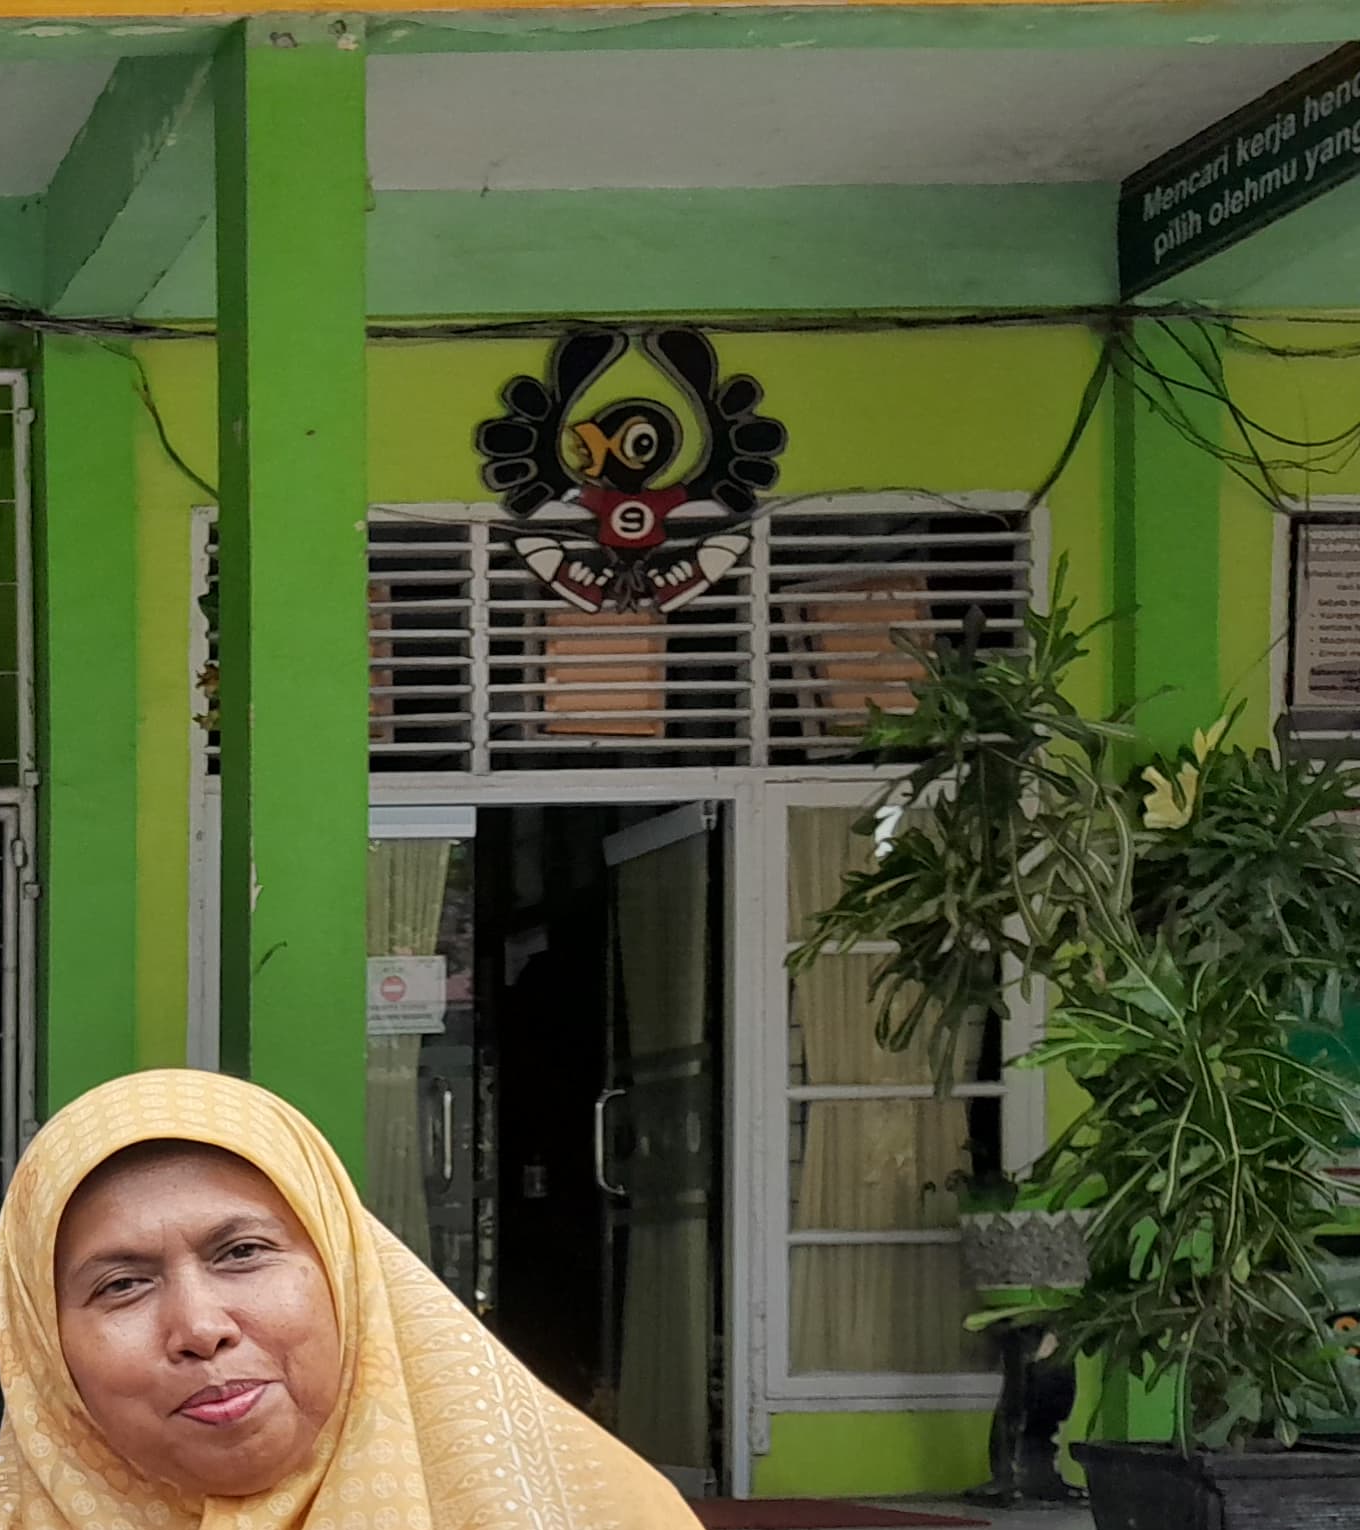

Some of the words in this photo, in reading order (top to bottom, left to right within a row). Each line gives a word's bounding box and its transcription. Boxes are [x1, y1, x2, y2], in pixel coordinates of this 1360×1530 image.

[1142, 145, 1230, 222] Mencari
[1236, 112, 1296, 167] kerja
[1153, 209, 1202, 264] pilih
[1208, 158, 1297, 226] olehmu
[619, 507, 644, 533] 9
